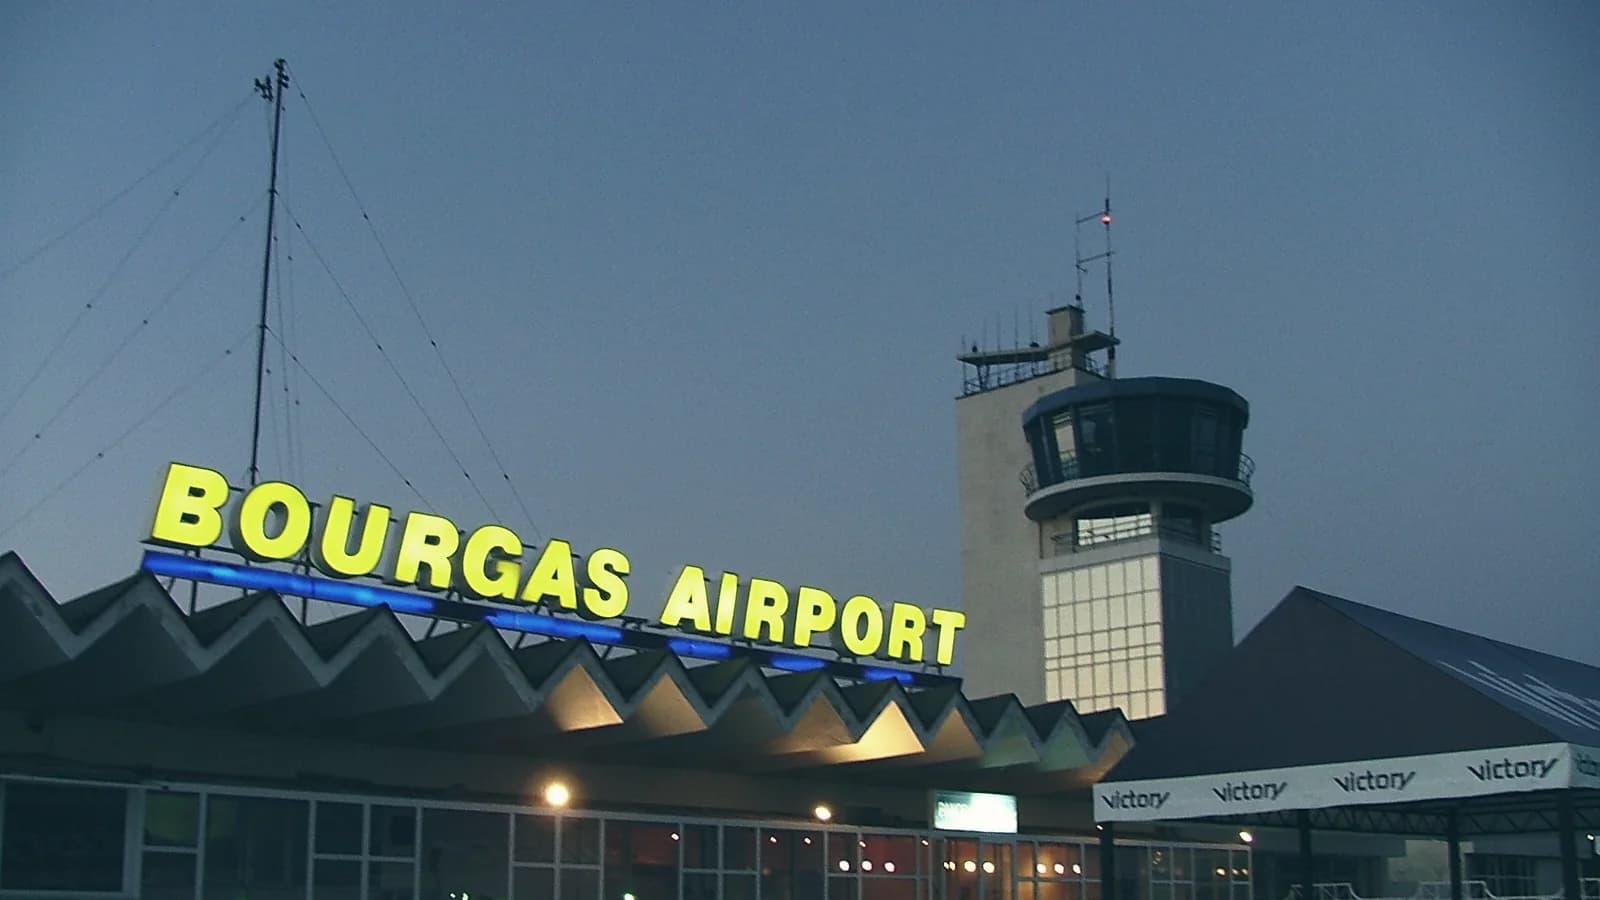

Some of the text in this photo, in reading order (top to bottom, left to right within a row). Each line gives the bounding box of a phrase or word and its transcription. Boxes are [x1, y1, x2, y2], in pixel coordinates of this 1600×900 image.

[151, 462, 966, 666] BOURGAS AIRPORT
[1466, 757, 1557, 781] victory
[1212, 781, 1287, 803] victory
[1333, 771, 1416, 793] victory
[1101, 790, 1169, 809] victory
